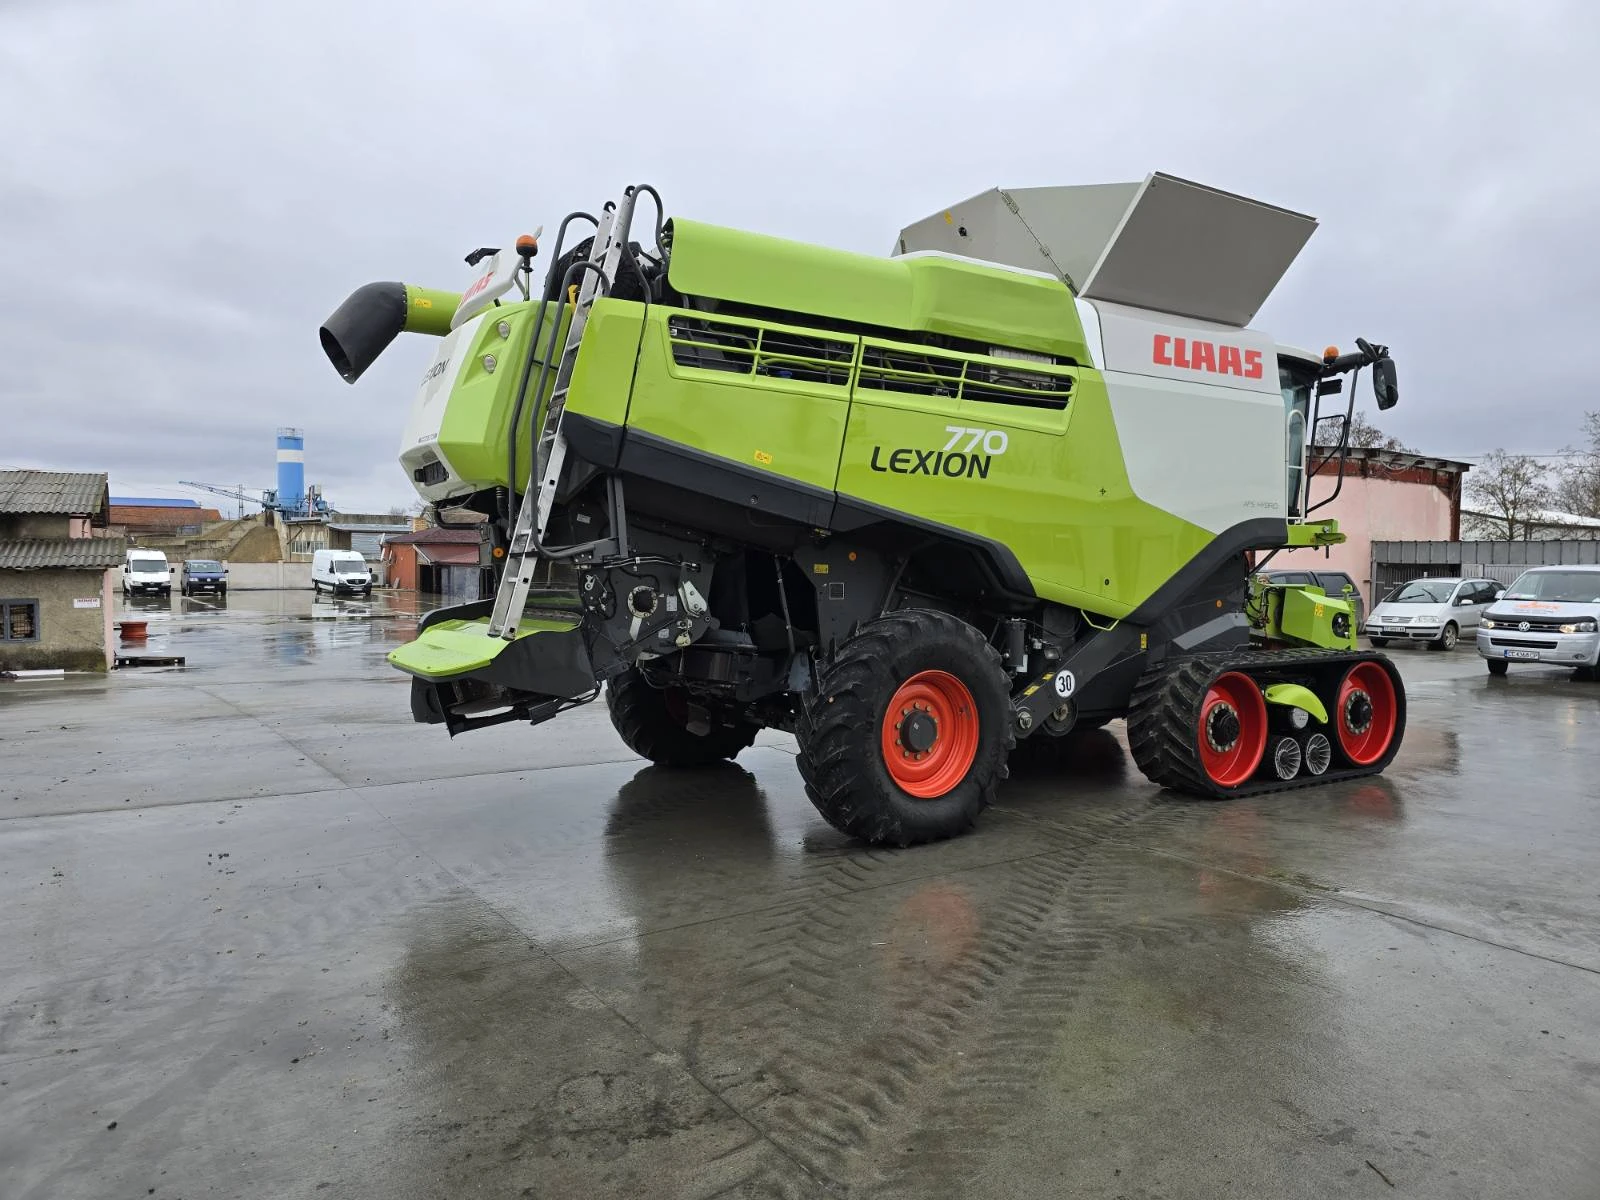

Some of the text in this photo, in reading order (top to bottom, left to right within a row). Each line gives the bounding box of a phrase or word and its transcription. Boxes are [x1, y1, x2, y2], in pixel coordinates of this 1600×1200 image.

[1153, 334, 1262, 379] CLAAS
[943, 425, 1009, 455] 770
[870, 446, 992, 479] LEXION
[1059, 675, 1072, 693] 30
